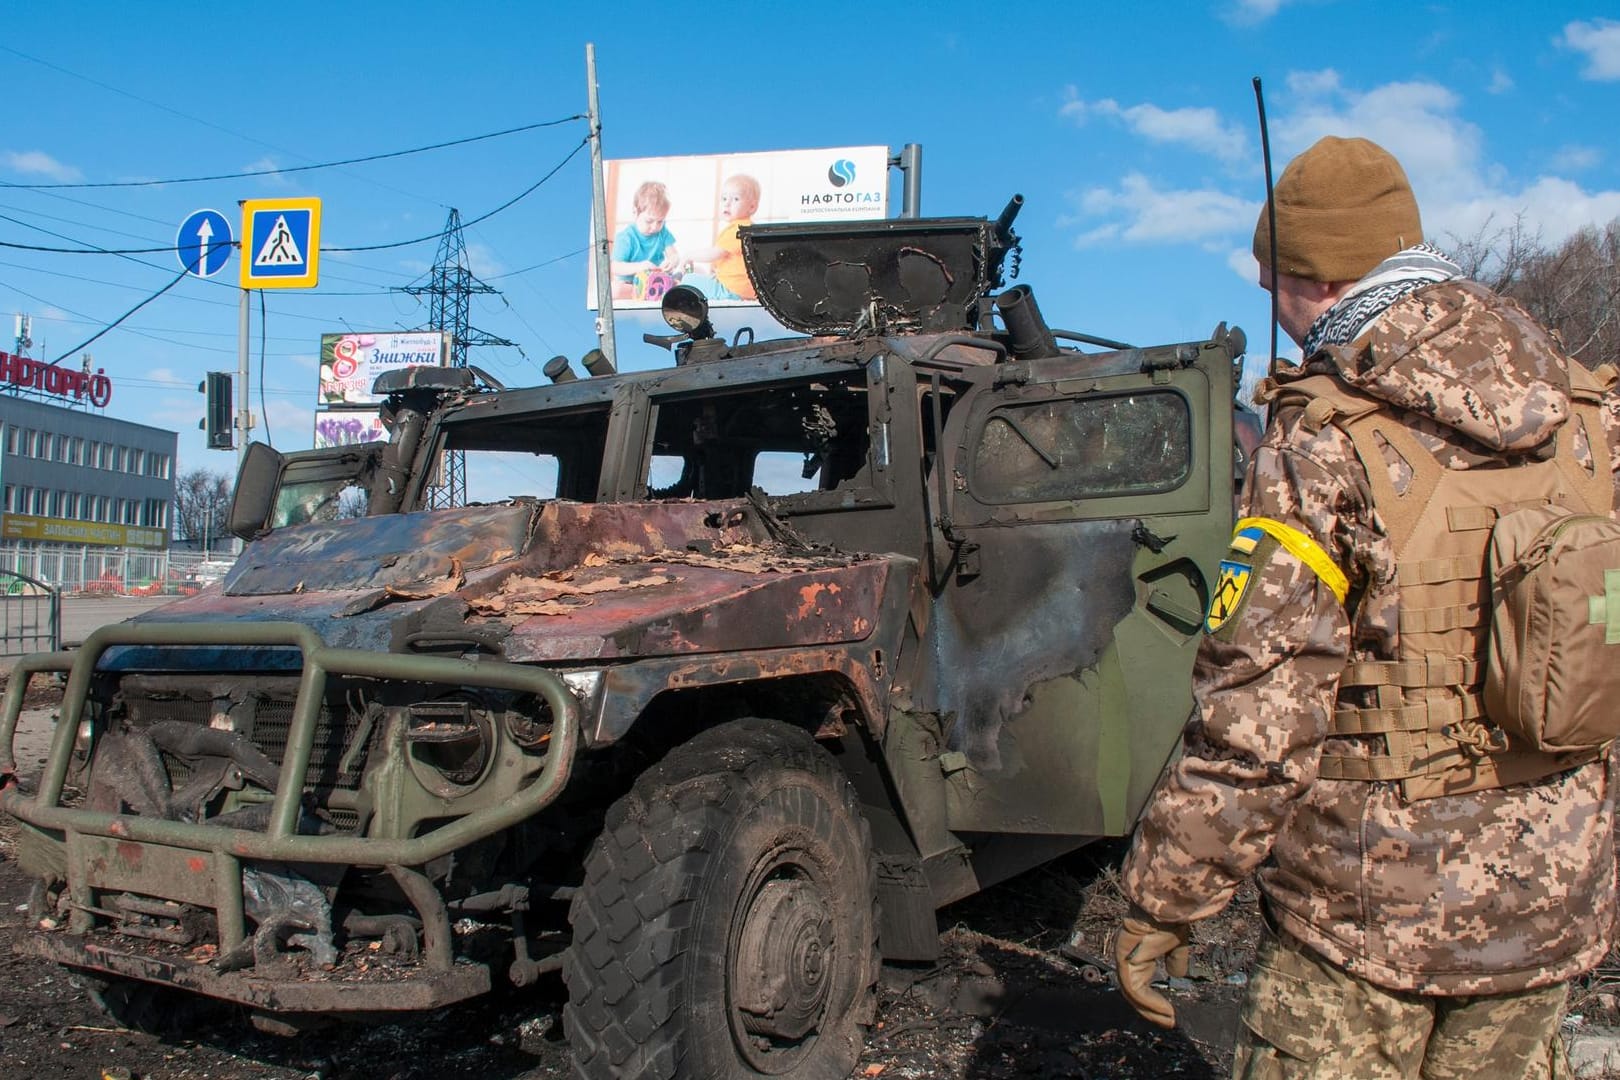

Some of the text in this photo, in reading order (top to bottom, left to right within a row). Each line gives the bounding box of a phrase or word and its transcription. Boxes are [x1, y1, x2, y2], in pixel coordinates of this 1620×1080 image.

[801, 192, 881, 204] НАФТОГАЗ
[332, 339, 359, 380] 8
[369, 348, 436, 364] Знижки
